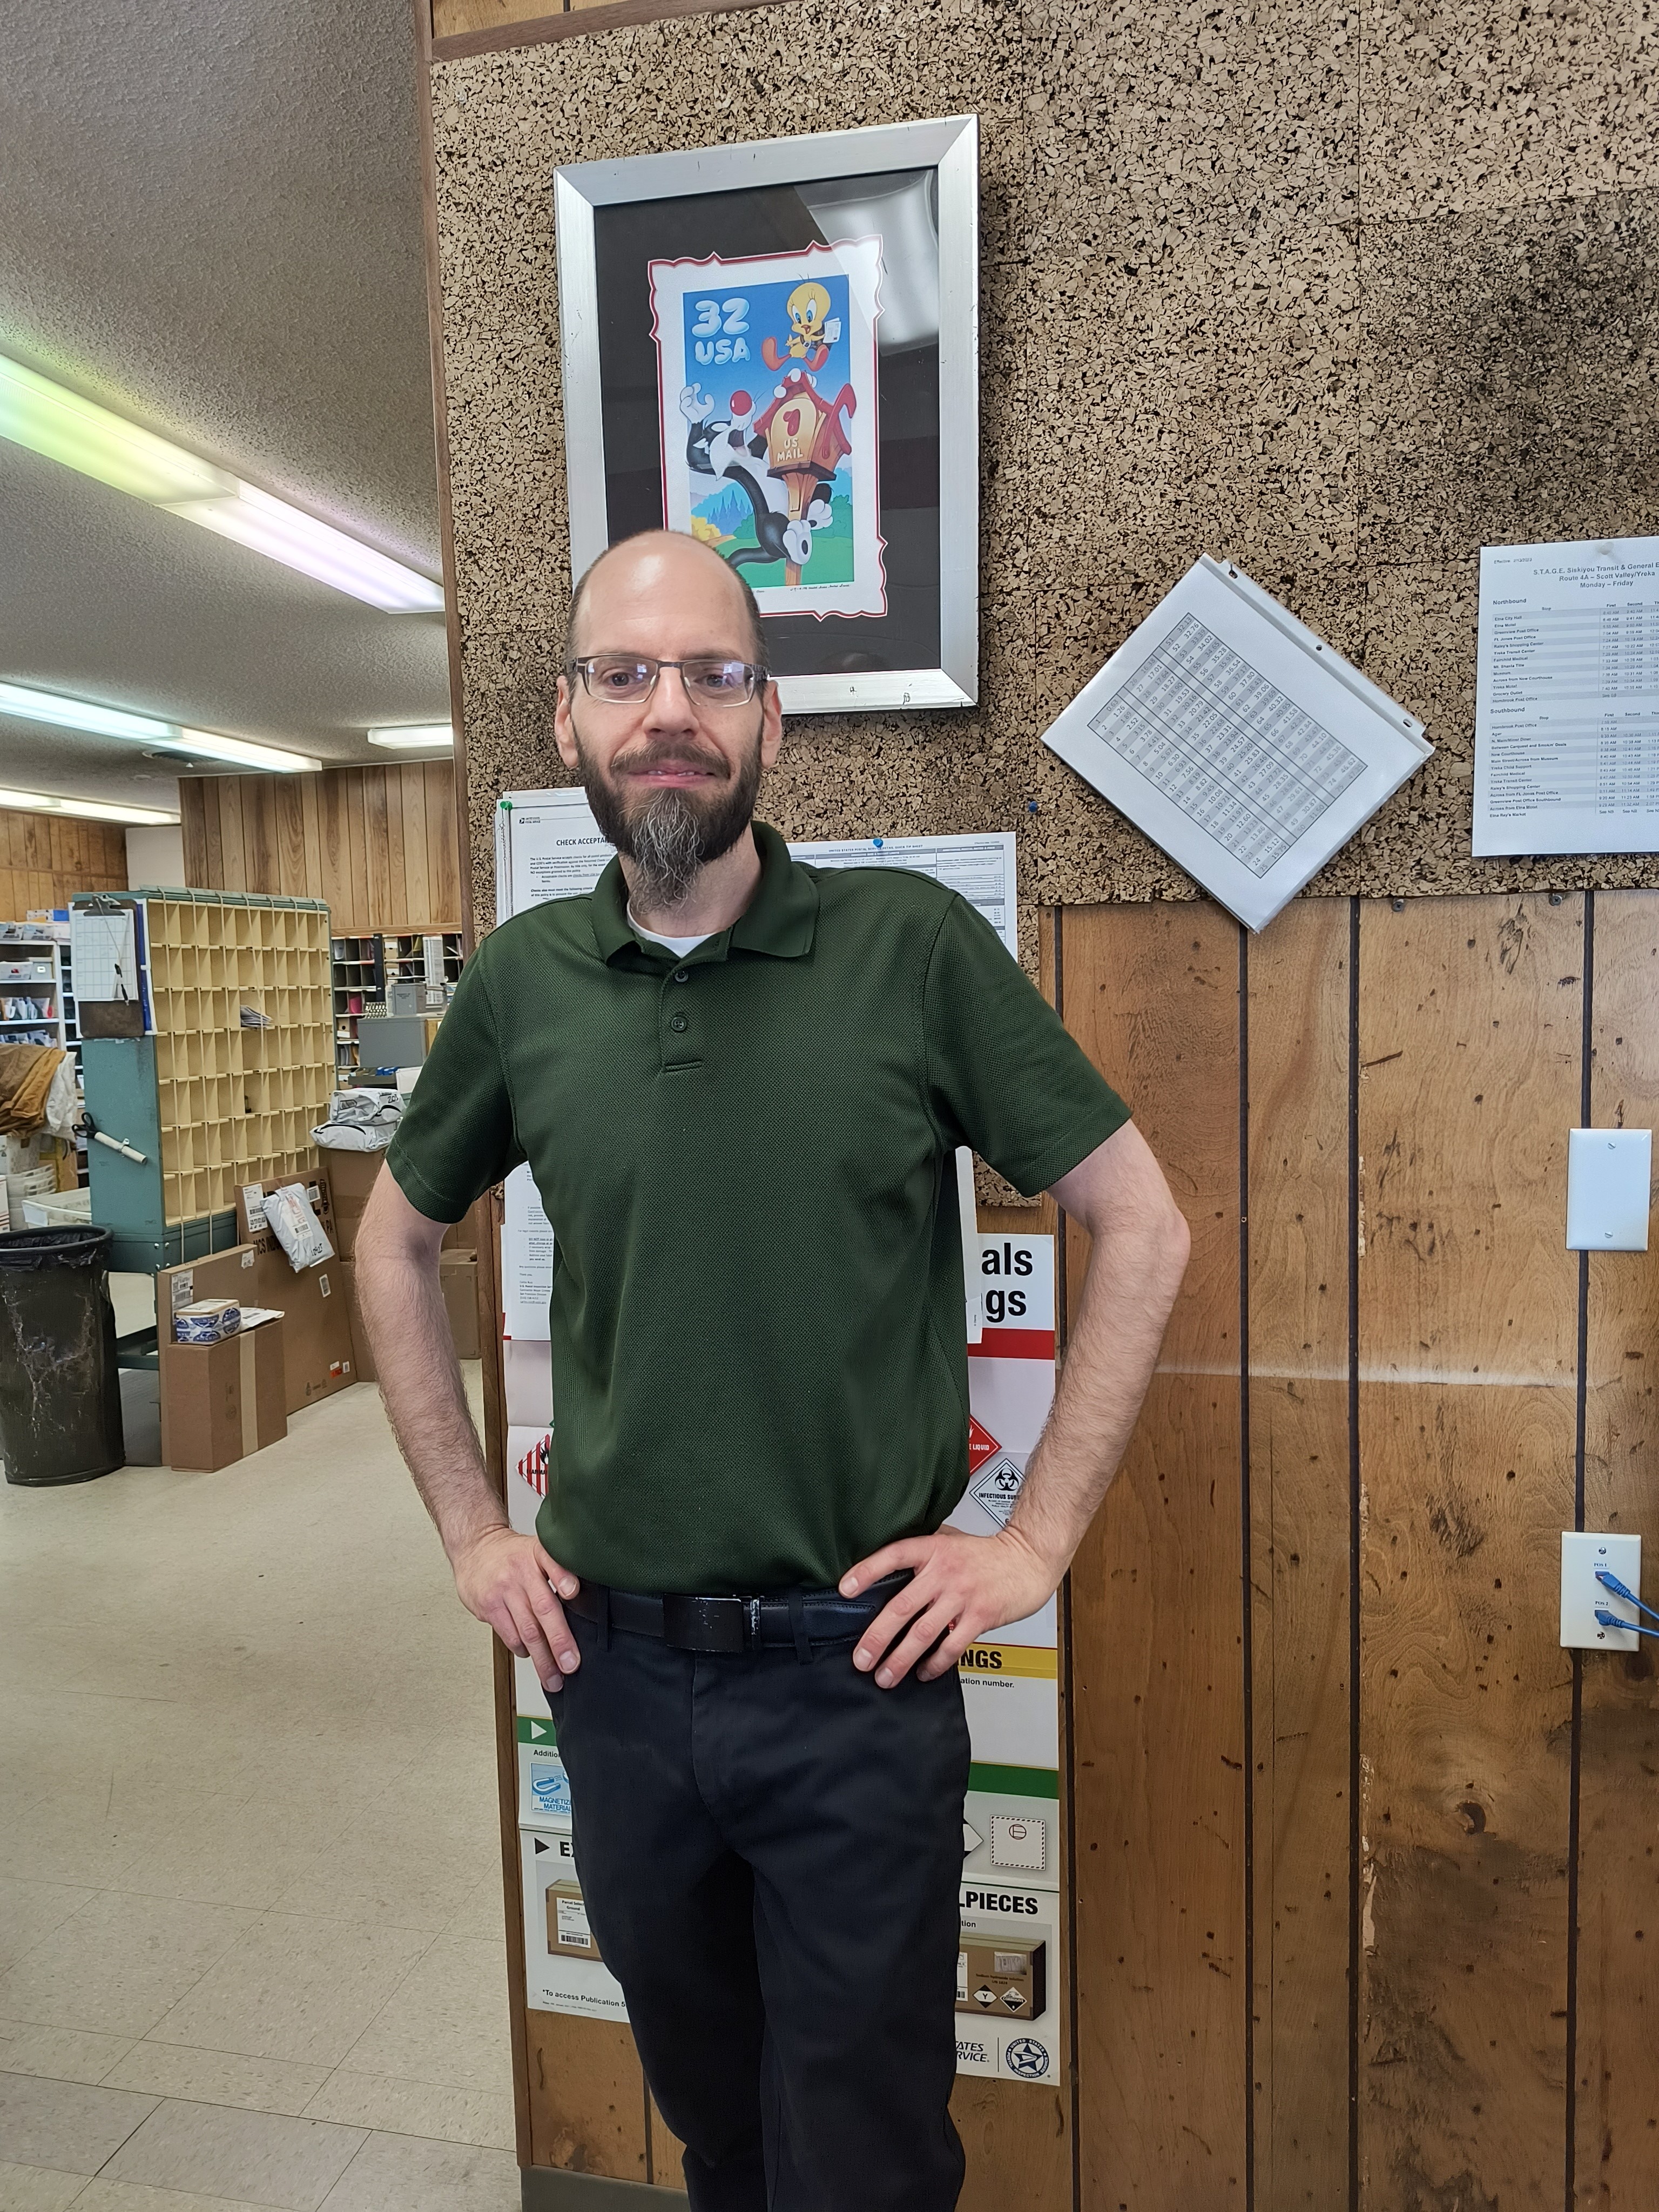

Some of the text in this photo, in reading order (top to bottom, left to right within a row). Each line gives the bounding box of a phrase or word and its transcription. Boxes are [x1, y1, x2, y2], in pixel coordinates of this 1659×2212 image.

[692, 298, 750, 338] 32
[695, 337, 751, 365] USA
[783, 409, 800, 436] 1
[778, 448, 803, 462] MAIL
[784, 437, 798, 449] US
[1113, 705, 1125, 717] 1.26
[1136, 684, 1143, 692] 27
[1148, 664, 1162, 679] 17.01
[1172, 643, 1181, 652] 52
[1183, 622, 1198, 639] 32.76
[1126, 717, 1138, 730] 2.52
[1150, 696, 1157, 704] 29
[1161, 676, 1175, 691] 18.27
[1186, 656, 1193, 664] 54
[1197, 635, 1212, 651] 34.02
[1169, 784, 1177, 792] 12
[1181, 766, 1193, 778] 7.56
[1205, 744, 1212, 753] 37
[1216, 725, 1231, 740] 23.31
[1253, 683, 1269, 700] 39.06
[1224, 833, 1232, 841] 20
[1236, 813, 1251, 828] 12.60
[1273, 773, 1288, 789] 28.35
[982, 1243, 1033, 1276] als
[986, 1290, 1026, 1323] gs
[581, 1995, 619, 2007] Publication
[1010, 2039, 1044, 2052] UNITED STATES
[1014, 2068, 1040, 2077] INSPECTION
